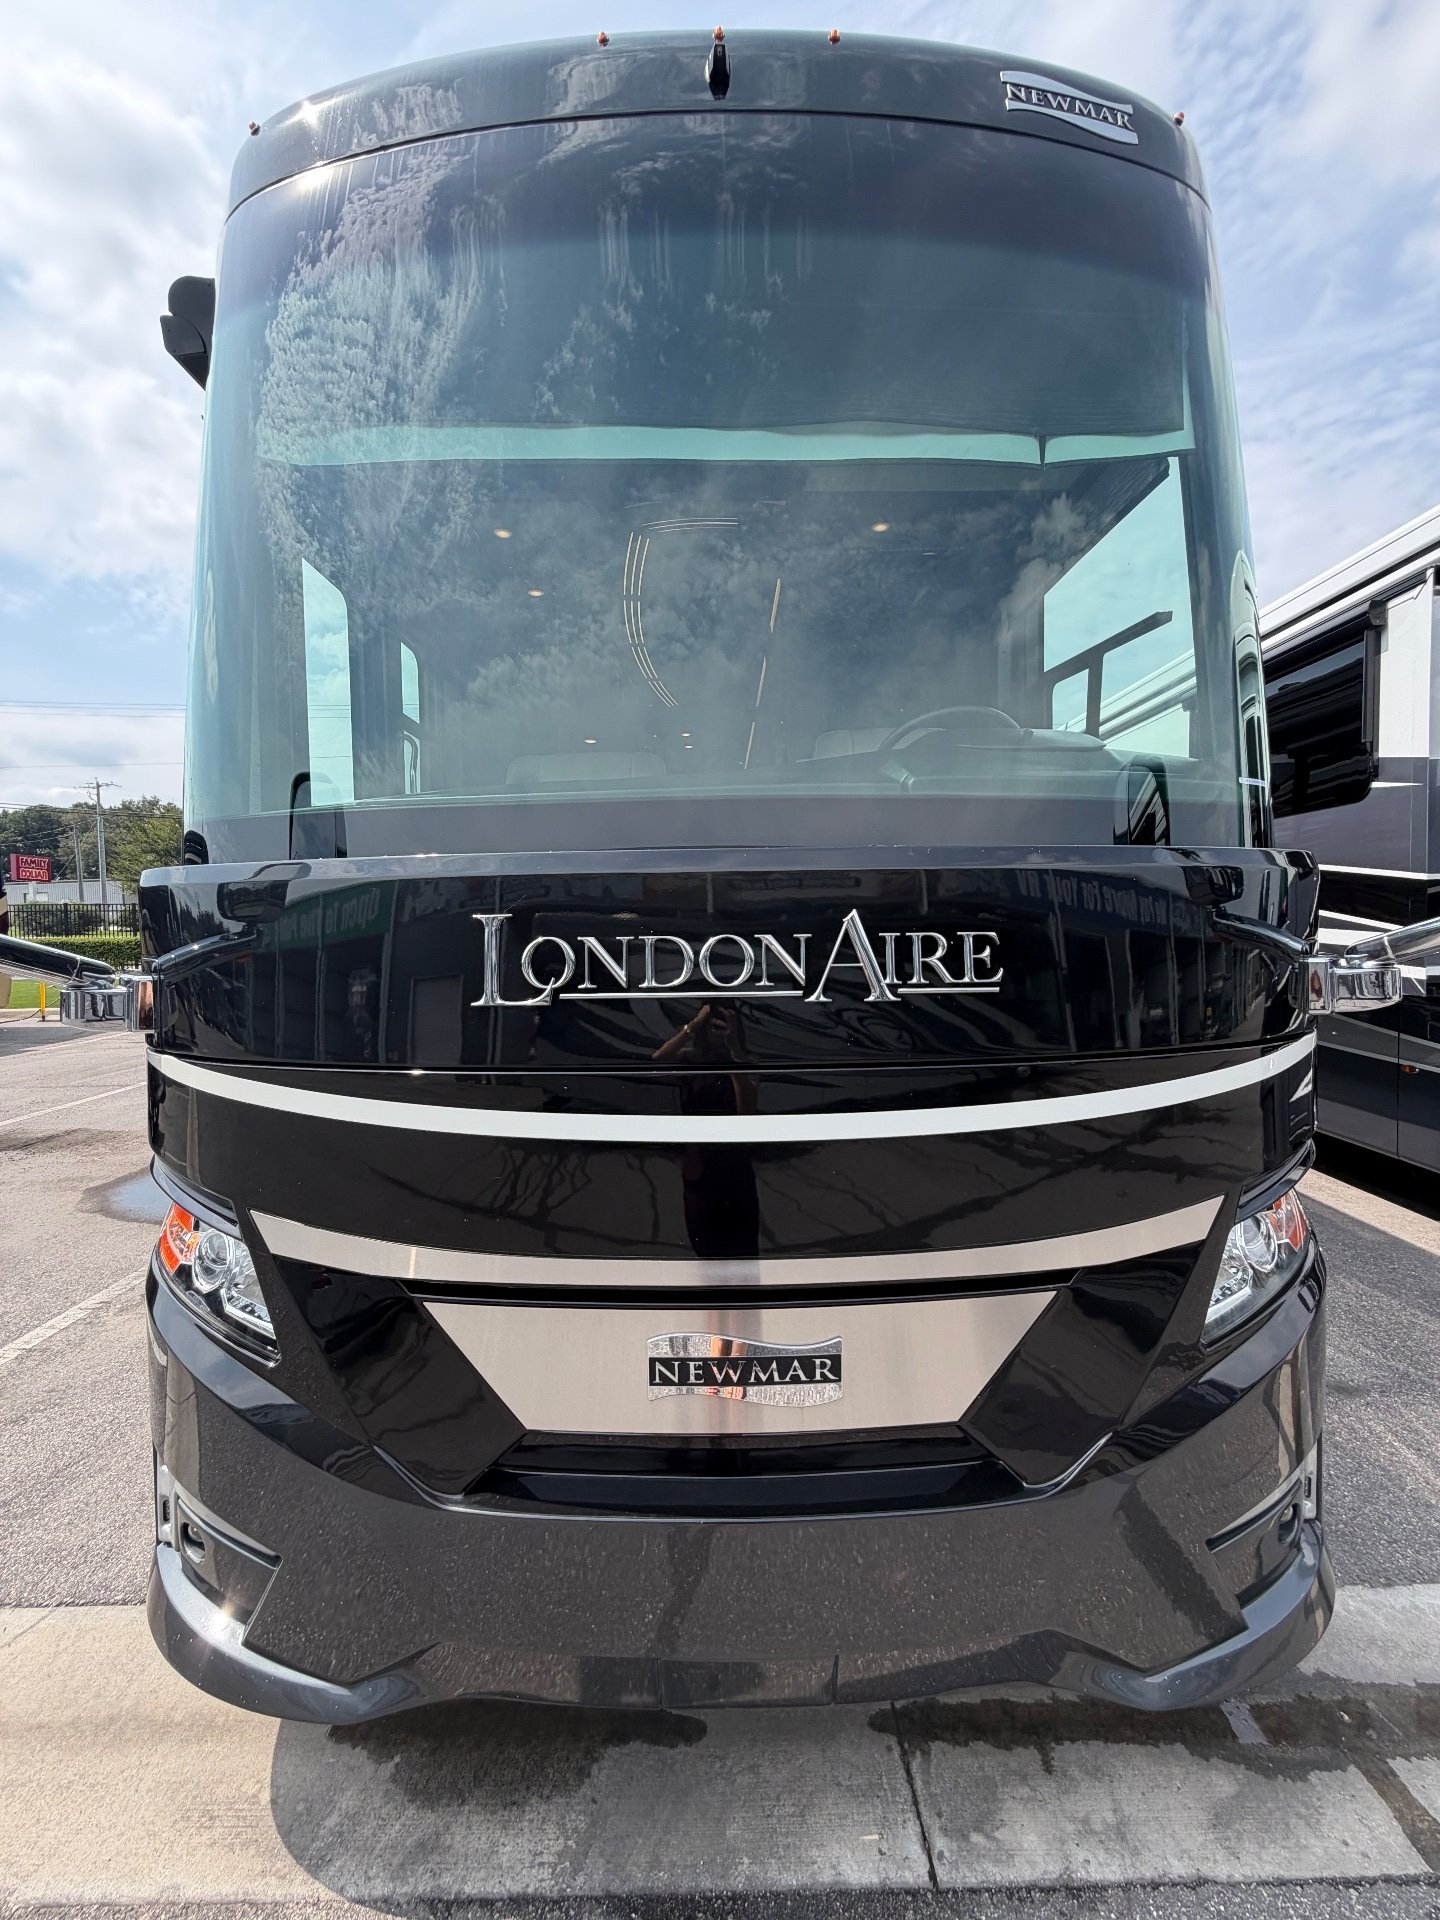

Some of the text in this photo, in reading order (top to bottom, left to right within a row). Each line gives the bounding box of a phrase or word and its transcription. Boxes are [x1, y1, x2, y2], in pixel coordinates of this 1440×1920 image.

[1006, 83, 1135, 131] NEWMAR
[19, 856, 48, 869] FAMILY
[19, 868, 48, 881] DOLLAR
[652, 1358, 839, 1384] NEWMAR
